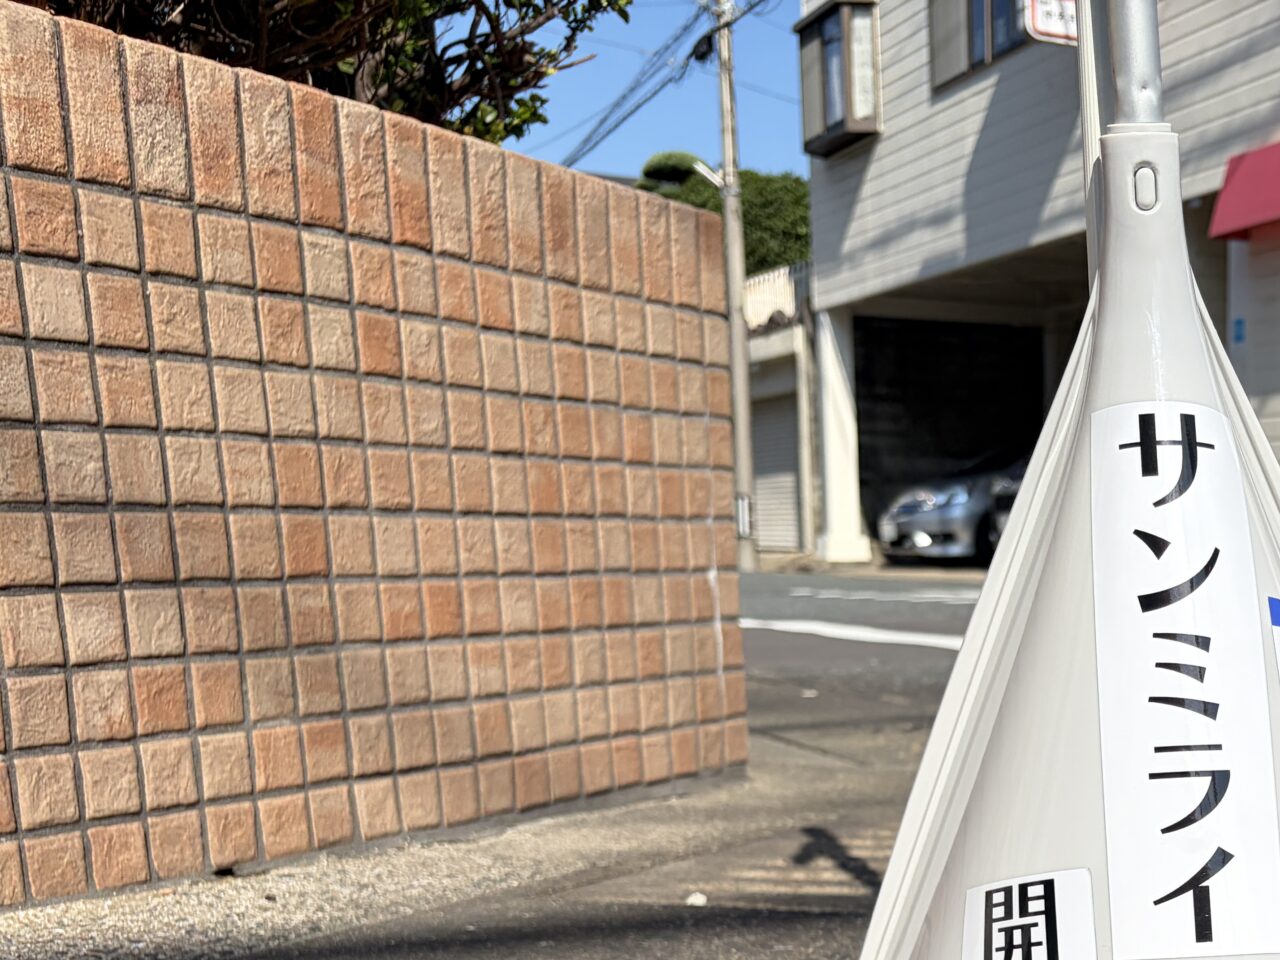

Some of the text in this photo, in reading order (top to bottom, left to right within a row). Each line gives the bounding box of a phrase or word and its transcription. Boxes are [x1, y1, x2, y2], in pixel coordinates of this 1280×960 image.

[1118, 413, 1236, 943] サンミライ
